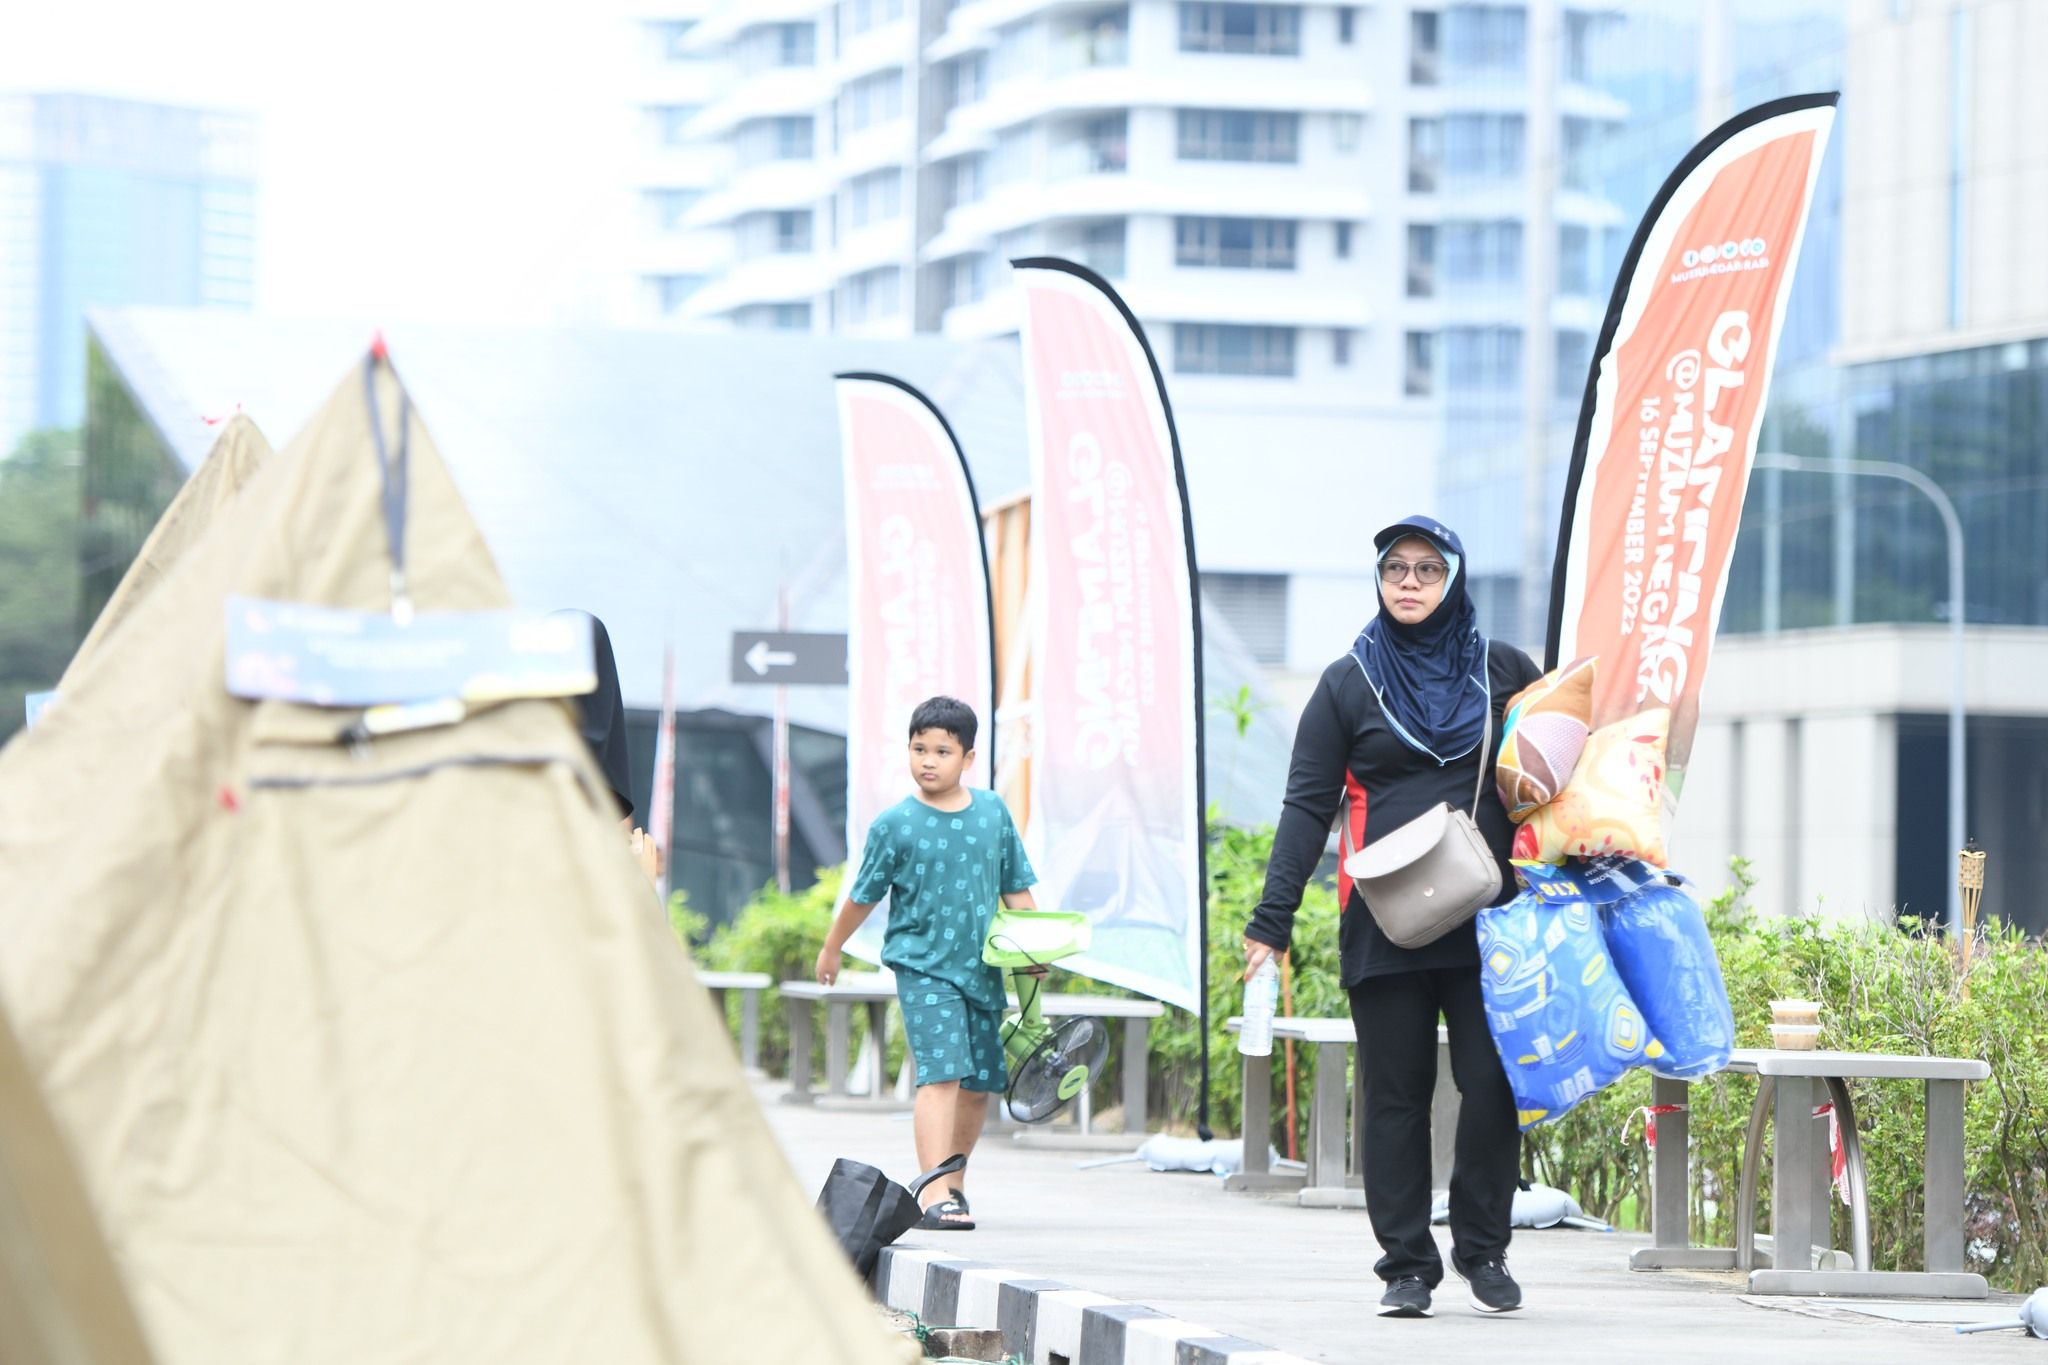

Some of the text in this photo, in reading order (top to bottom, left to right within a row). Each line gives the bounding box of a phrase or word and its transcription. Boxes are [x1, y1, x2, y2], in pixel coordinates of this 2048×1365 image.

[1622, 397, 1661, 635] 16 SEPTEMBER 2022
[1656, 350, 1701, 537] @MUZIUM
[1540, 881, 1581, 898] K18
